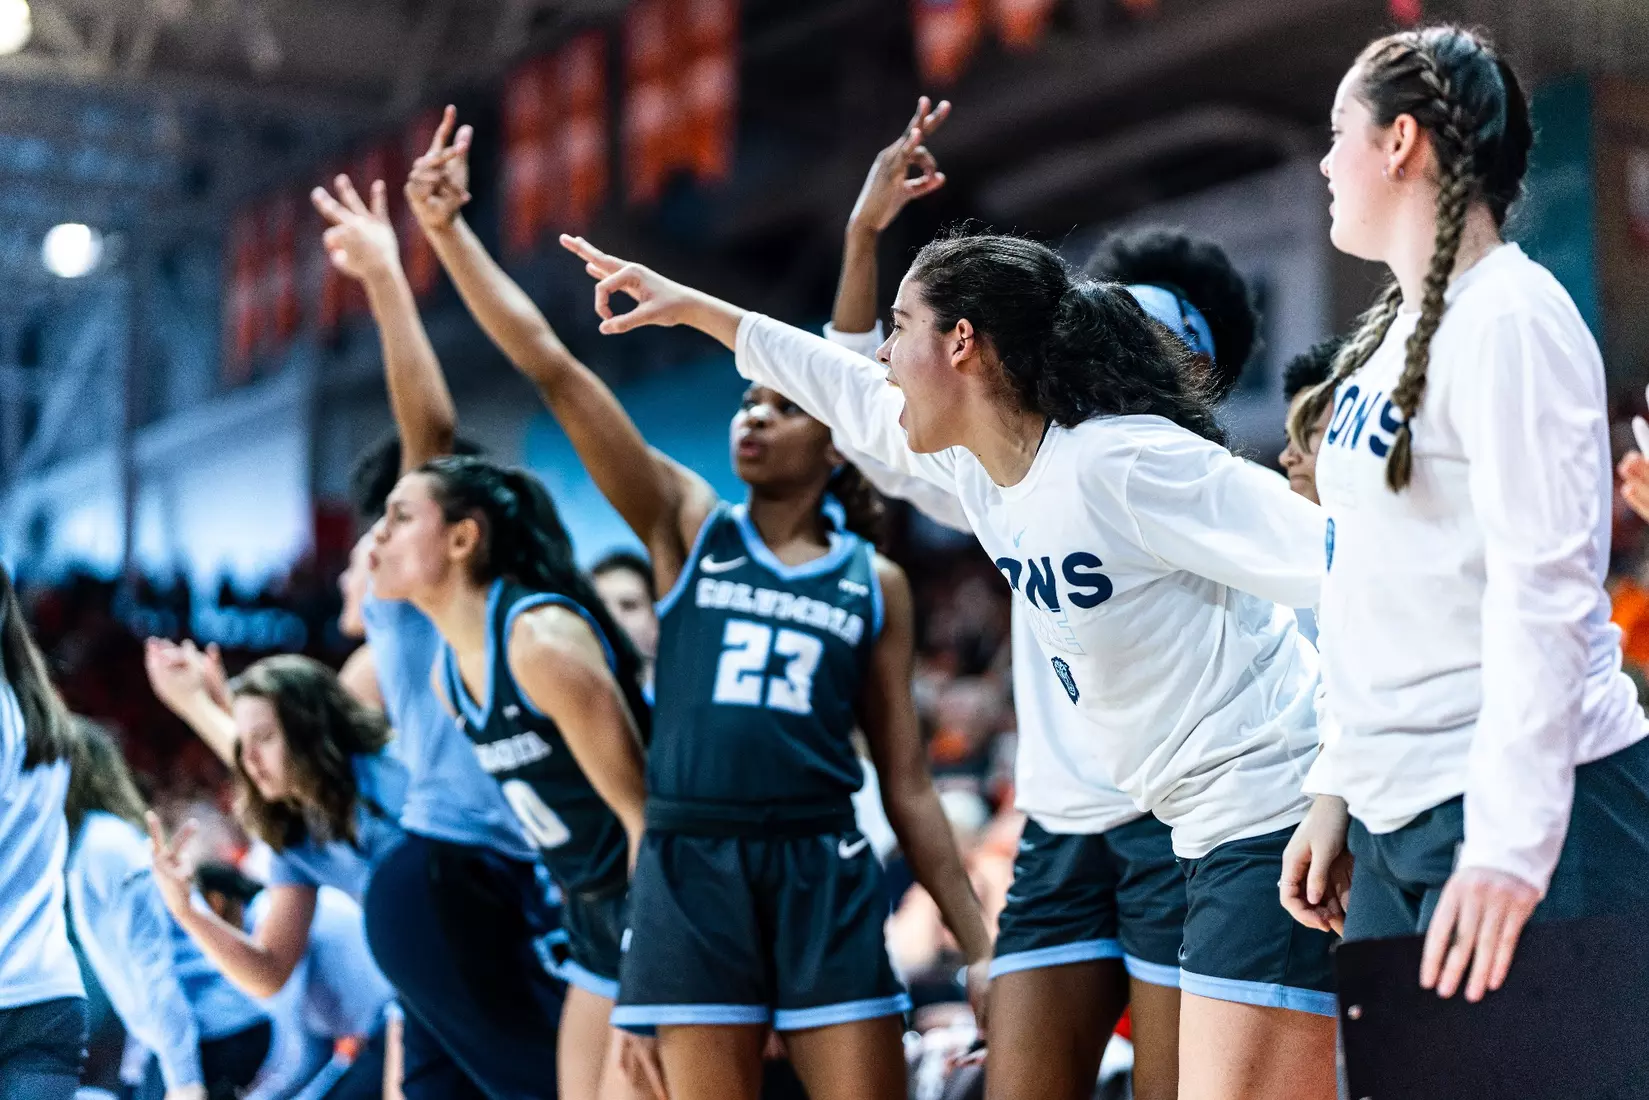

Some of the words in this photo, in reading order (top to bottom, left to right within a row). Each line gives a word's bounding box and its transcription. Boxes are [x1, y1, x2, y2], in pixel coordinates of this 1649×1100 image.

[1328, 385, 1413, 458] ONS
[696, 577, 865, 647] COLUMBIA
[712, 618, 825, 716] 23
